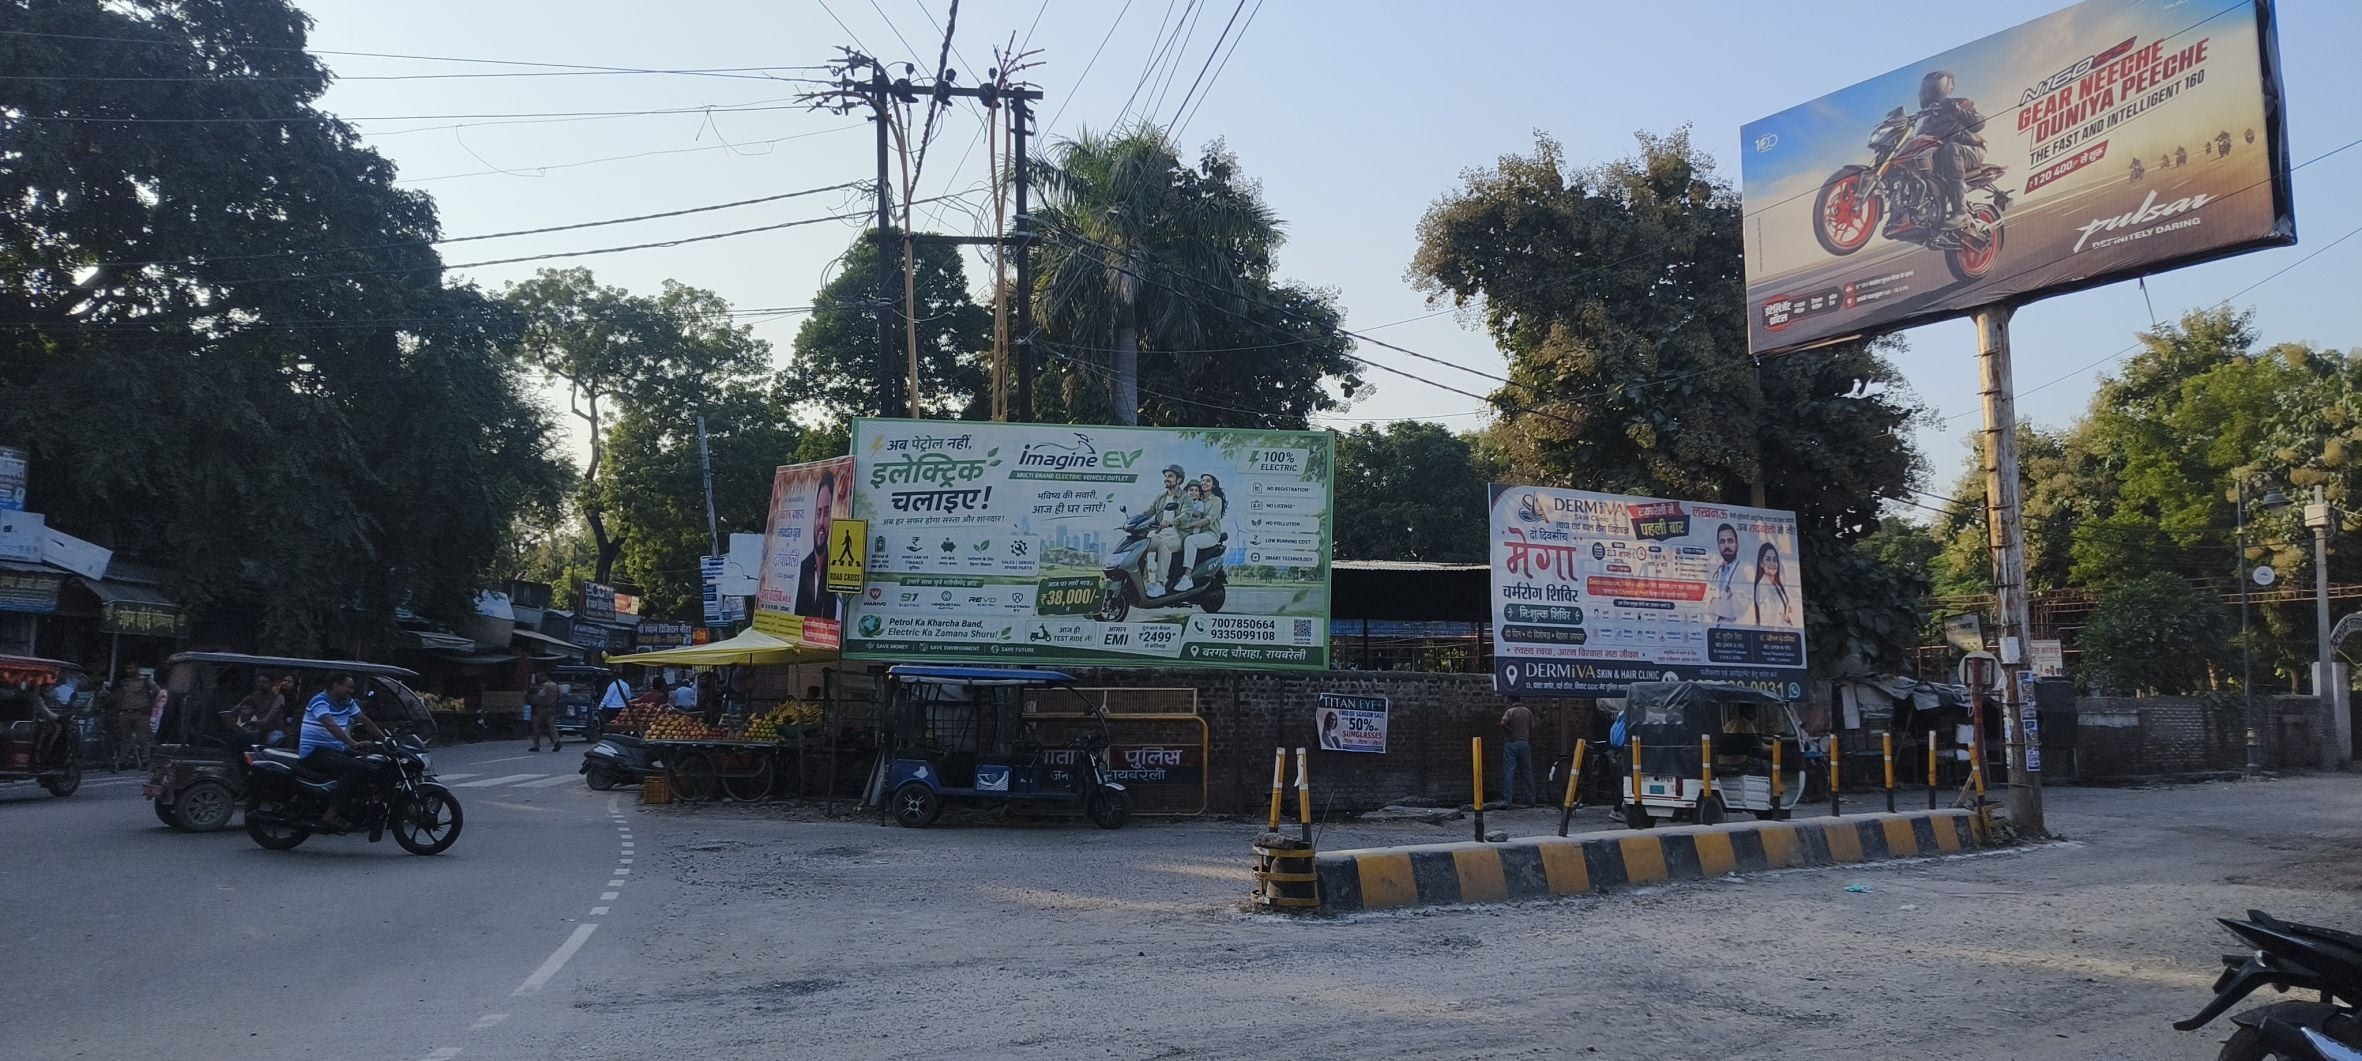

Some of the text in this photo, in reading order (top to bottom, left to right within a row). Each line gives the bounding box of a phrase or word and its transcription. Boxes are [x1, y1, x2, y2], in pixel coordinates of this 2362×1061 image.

[2017, 37, 2164, 131] GEAR NEECHE
[2035, 37, 2210, 144] DUNIYA PEECHE
[2030, 69, 2206, 166] THE FAST AND INTELLIGENT 160
[2092, 217, 2201, 250] DEFINITELY DARING
[887, 434, 972, 452] अब पेट्रोल नहीं,
[1019, 444, 1144, 470] imagine EV
[1263, 451, 1295, 463] 100%
[870, 453, 987, 489] इलेक्ट्रिक
[1260, 464, 1298, 472] ELECTRIC
[1034, 472, 1054, 480] BRAND
[1055, 472, 1082, 480] ELECTRIC
[1107, 474, 1128, 482] OUTLET
[892, 486, 993, 514] चलाइए!
[1038, 490, 1098, 500] भविष्य की सवारी,
[1032, 504, 1053, 514] आज
[1054, 502, 1064, 514] ही
[1067, 503, 1080, 513] घर
[1692, 506, 1728, 520] लखनऊ
[1640, 518, 1685, 536] पहली बार
[1530, 526, 1569, 542] दो दिवसीय
[1504, 527, 1578, 582] मेगा
[830, 572, 860, 582] ROAD CROSS
[900, 593, 918, 601] 91
[1040, 588, 1100, 607] ₹38,000/-
[1503, 584, 1542, 601] चर्मरोग
[1546, 584, 1579, 602] शिविर
[1550, 608, 1571, 620] शिविर
[889, 618, 984, 629] Petrol Ka Kharcha Band,
[1211, 618, 1275, 630] 7007850664
[888, 628, 999, 638] Electric Ka Zamana Shuru!
[1211, 630, 1275, 640] 9335099108
[1104, 634, 1129, 646] EMI
[1596, 669, 1613, 678] SKIN
[1614, 670, 1620, 678] &
[1621, 670, 1637, 680] HAIR
[1638, 670, 1660, 680] CLINIC
[1323, 696, 1356, 709] TITAN
[1349, 718, 1374, 731] 50%
[1343, 730, 1382, 739] SUNGLASSES
[1124, 746, 1183, 769] पुलिस
